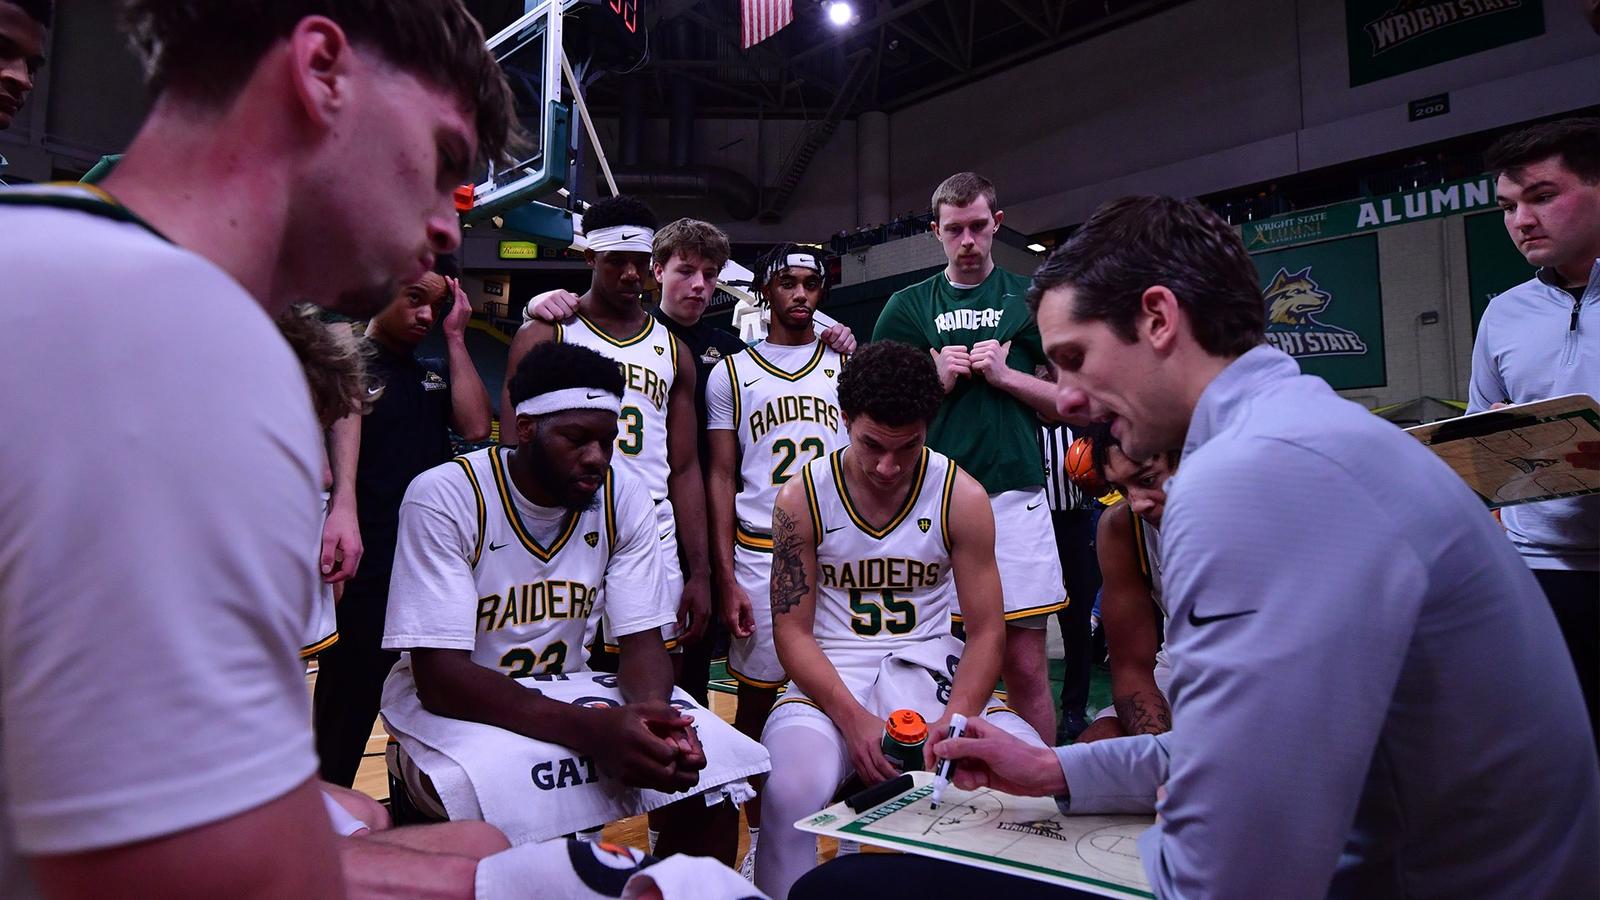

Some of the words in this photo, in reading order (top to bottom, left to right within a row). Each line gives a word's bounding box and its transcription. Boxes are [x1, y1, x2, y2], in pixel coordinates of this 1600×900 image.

[1373, 2, 1459, 49] WRIGHT
[1415, 103, 1445, 117] 200
[1254, 218, 1295, 232] WRIGHT
[1297, 212, 1328, 225] STATE
[1356, 178, 1498, 228] ALUMN
[934, 307, 1004, 334] RAIDERS
[1304, 332, 1363, 353] STATE
[749, 395, 839, 443] RAIDERS
[821, 558, 940, 588] RAIDERS
[476, 580, 597, 632] RAIDERS
[849, 587, 917, 636] 55
